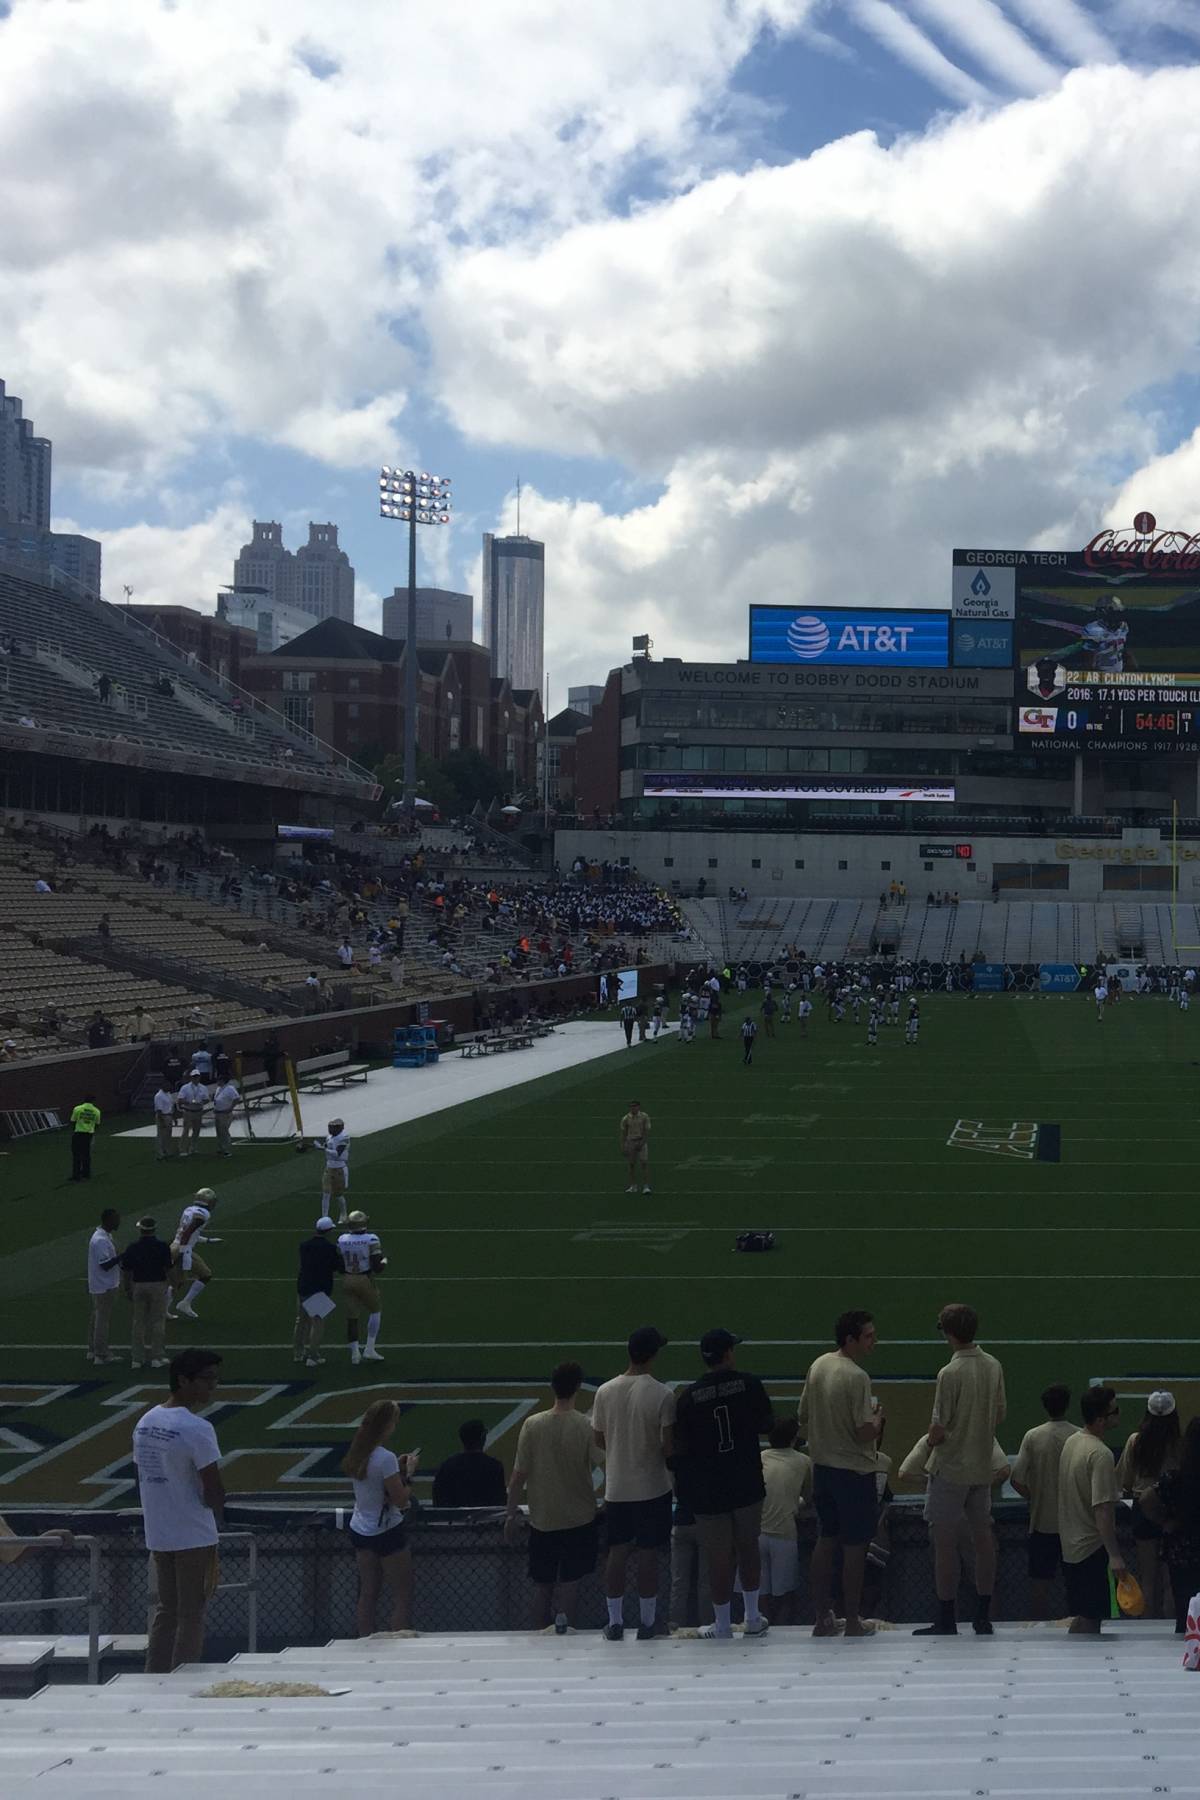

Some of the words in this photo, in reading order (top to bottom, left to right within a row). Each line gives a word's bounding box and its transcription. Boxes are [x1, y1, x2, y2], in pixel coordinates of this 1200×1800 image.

[966, 552, 1028, 564] GEORGIA
[1032, 553, 1067, 565] TECH
[963, 598, 999, 608] Georgia
[955, 609, 990, 617] Natural
[993, 609, 1009, 618] Gas
[837, 626, 914, 652] AT&T
[977, 638, 1008, 649] AT&T
[678, 671, 760, 685] WELCOME
[767, 672, 789, 686] TO
[795, 672, 849, 687] BOBBY
[856, 674, 901, 688] DODD
[907, 674, 979, 689] STADIUM
[1067, 671, 1079, 683] 22
[1104, 673, 1143, 685] CLINTON
[1145, 674, 1176, 686] LYNCH
[1067, 688, 1093, 700] 2016:
[1098, 689, 1115, 701] 17.1
[1117, 689, 1136, 701] YDS
[1138, 689, 1155, 702] PER
[1158, 690, 1187, 702] TOUCH
[1024, 709, 1054, 729] GT
[1067, 711, 1077, 730] 0
[1184, 721, 1189, 733] 1
[1031, 740, 1081, 750] NATIONAL
[1087, 741, 1148, 751] CHAMPIONS
[1154, 742, 1172, 751] 1917
[1056, 840, 1159, 864] Georgia
[1054, 974, 1076, 983] AT&T
[713, 1405, 734, 1453] 1
